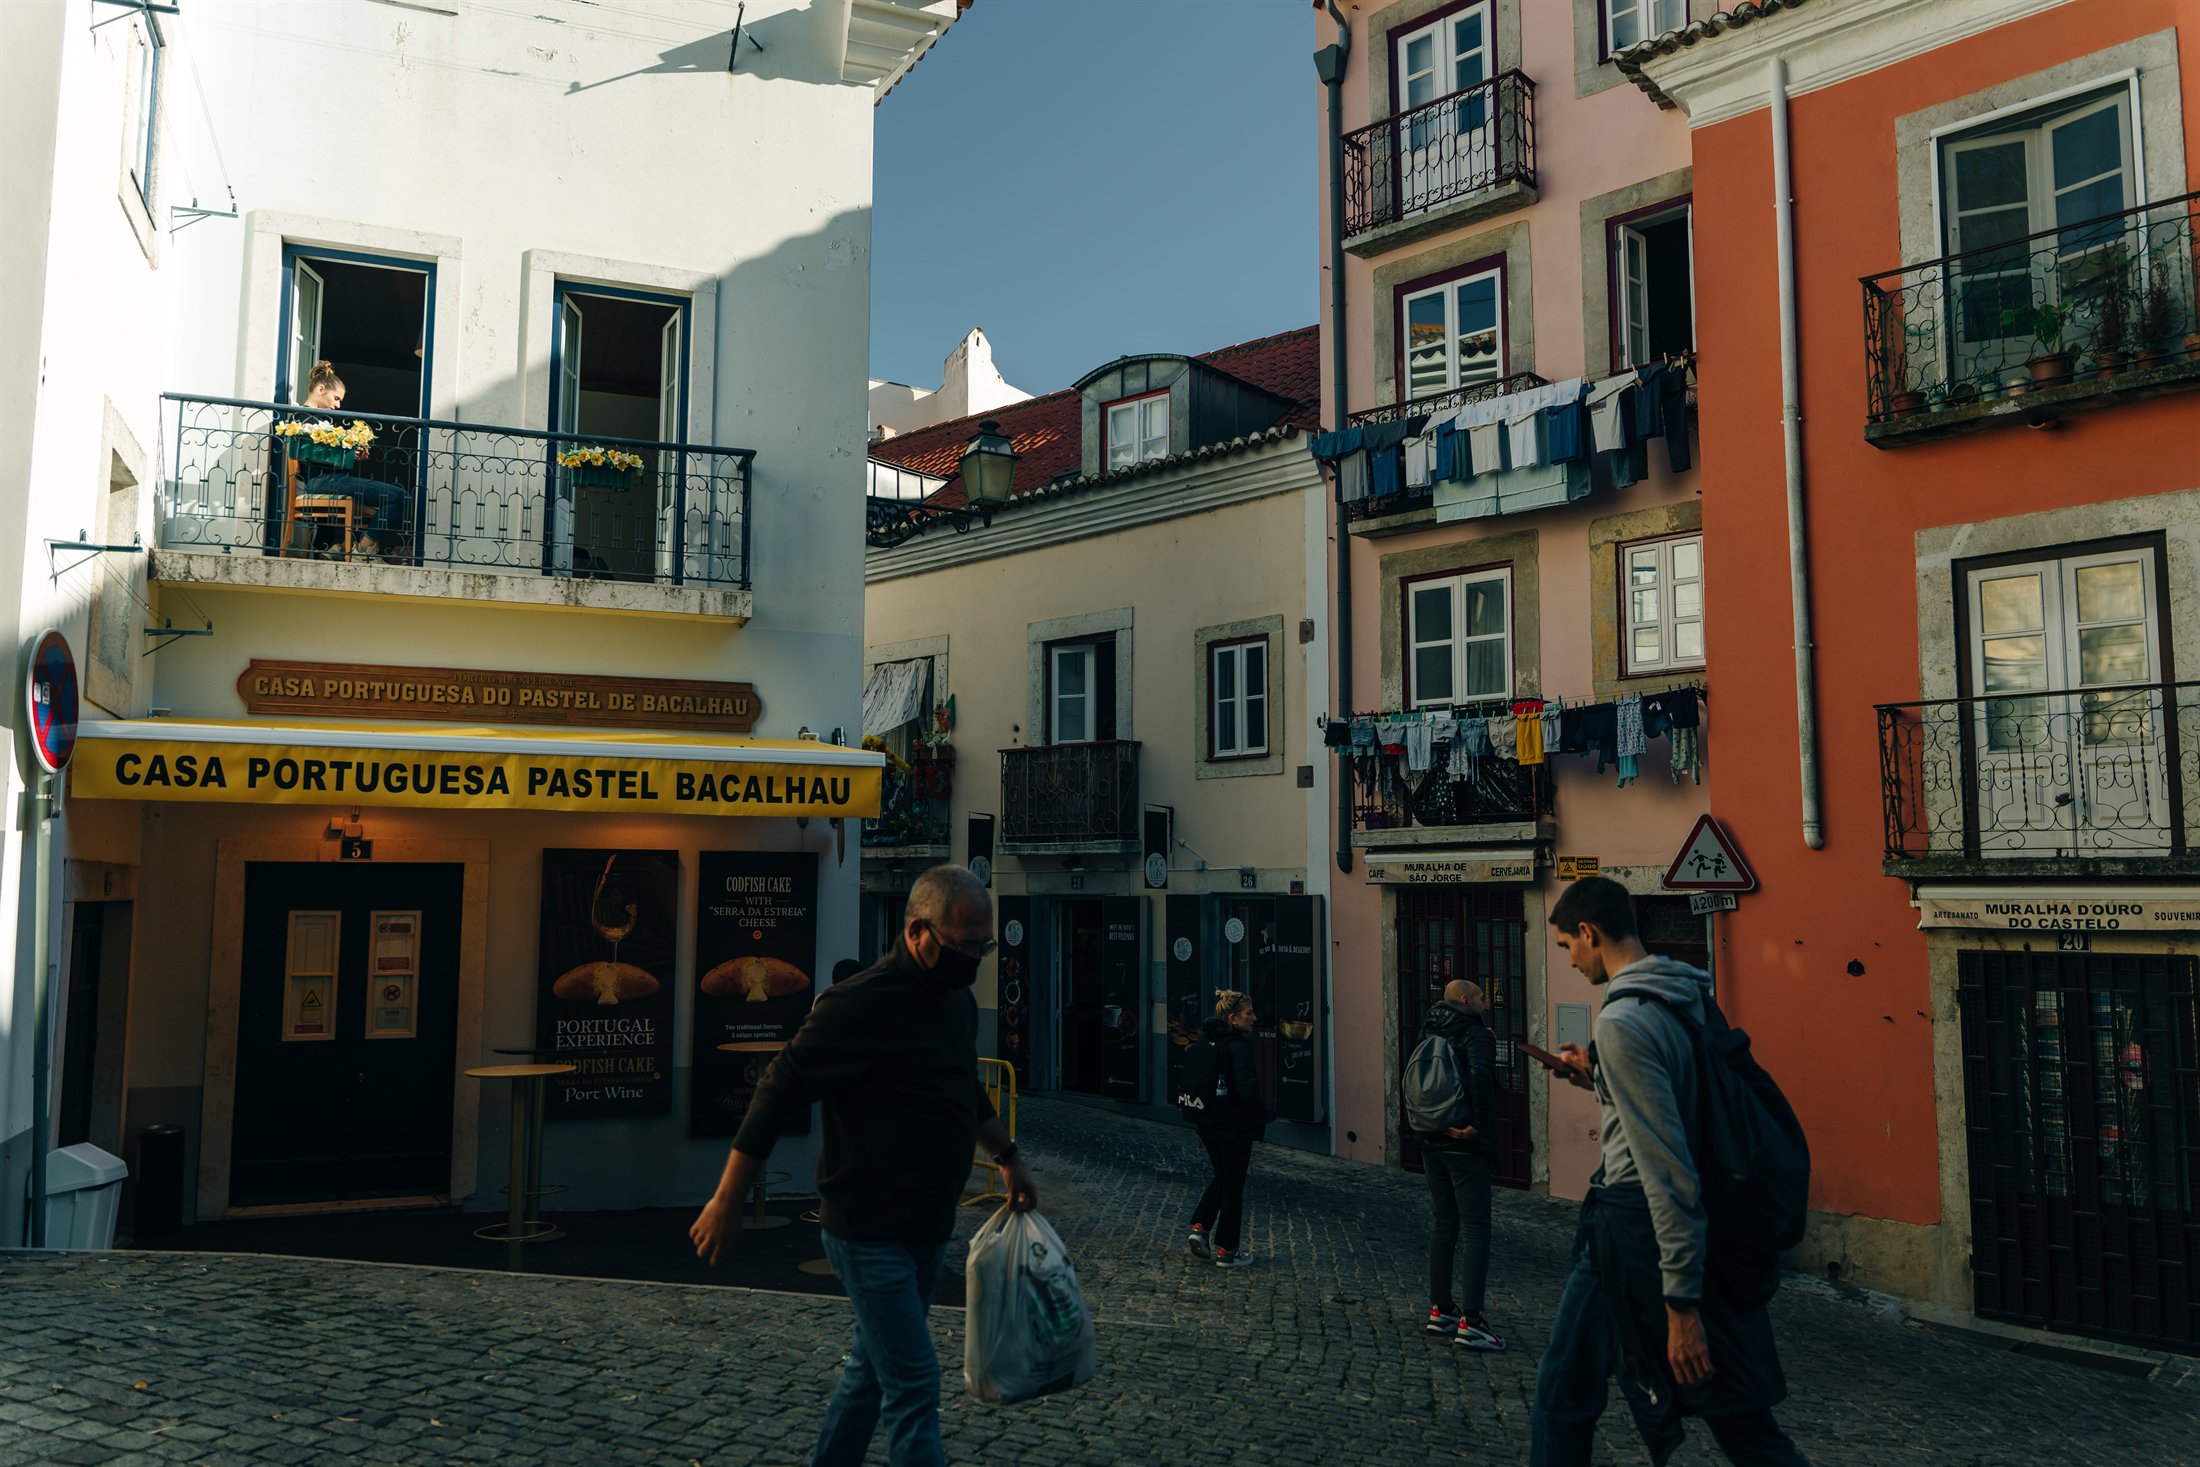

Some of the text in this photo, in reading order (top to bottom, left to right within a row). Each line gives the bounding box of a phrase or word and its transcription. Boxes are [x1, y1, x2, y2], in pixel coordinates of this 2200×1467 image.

[453, 672, 576, 688] PORTUGAL EXPERIENCE
[255, 676, 748, 717] CASA PORTUGUESA DO PASTEL DE BACALHAU
[115, 753, 850, 805] CASA PORTUGUESA PASTEL BACALHAU
[351, 840, 362, 859] 5
[1368, 866, 1531, 882] CAFÉ SÃO JORGE CERVEJARIA
[1404, 863, 1467, 872] MURALHA DE
[726, 876, 792, 893] CODFISH CAKE
[1242, 875, 1253, 887] 26
[744, 896, 773, 906] WITH
[748, 907, 761, 916] DA
[1985, 904, 2072, 916] MURALHA
[739, 918, 777, 928] CHEESE
[1933, 911, 1979, 920] ARTESANATO
[2008, 917, 2033, 929] DO
[2038, 918, 2120, 930] CASTELO
[2062, 932, 2085, 951] 20
[556, 1018, 655, 1034] PORTUGAL
[556, 1033, 655, 1048] EXPERIENCE
[618, 1056, 655, 1073] CAKE
[562, 1086, 645, 1104] Port Wine
